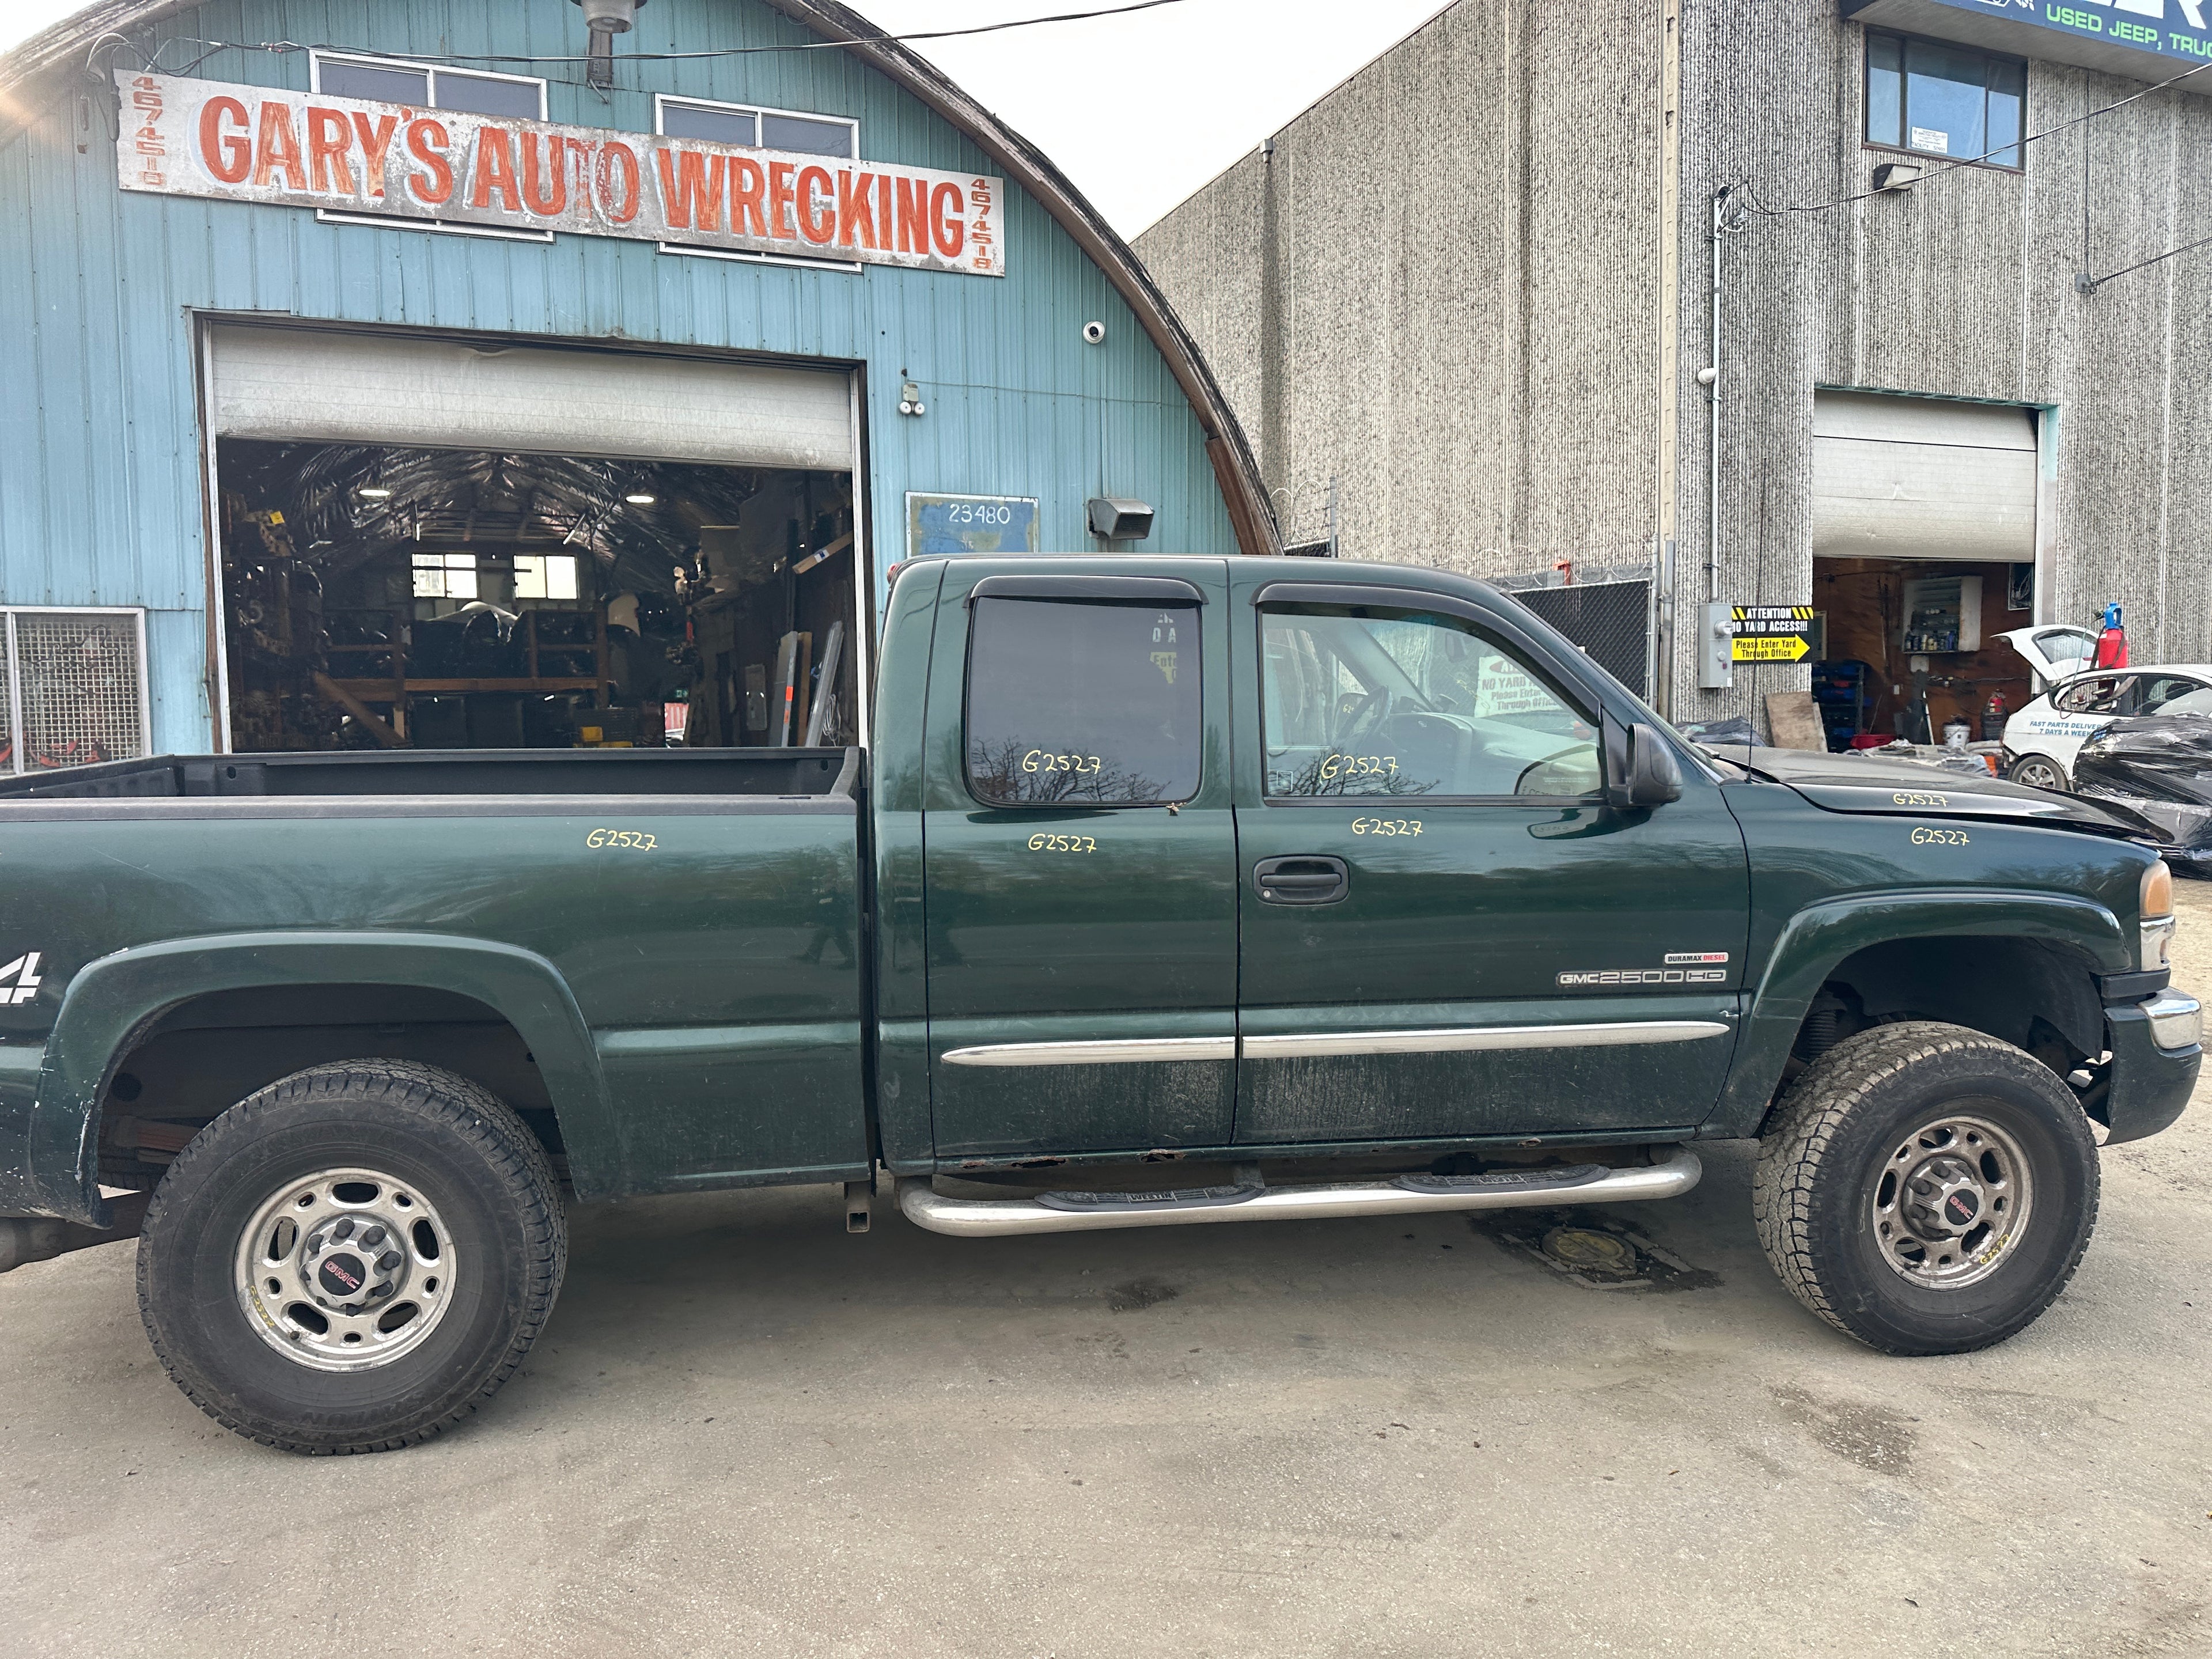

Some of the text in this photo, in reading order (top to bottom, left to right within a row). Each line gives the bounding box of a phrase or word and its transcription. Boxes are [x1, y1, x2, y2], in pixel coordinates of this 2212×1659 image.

[2046, 3, 2103, 33] USED
[2109, 21, 2162, 51] JEEP,
[198, 92, 965, 259] GARY'S AUTO WRECKING
[948, 503, 1011, 525] 23480
[1746, 607, 1791, 619] ATTENTION
[1744, 621, 1766, 632] YARD
[1768, 620, 1808, 632] ACCESS!!!
[1736, 639, 1796, 649] Please Enter Yard
[1741, 649, 1791, 658] Through Office
[1482, 678, 1495, 690] NO
[1491, 691, 1518, 700] Please
[1497, 698, 1531, 710] Through
[1021, 749, 1101, 774] G2527
[1321, 754, 1399, 779] G2527
[1893, 793, 1949, 806] G2527
[1351, 817, 1423, 837] G2527
[1911, 827, 1970, 846] G2527
[586, 828, 658, 851] G2527
[1027, 833, 1097, 853] G2527
[1949, 1195, 1974, 1219] GMC
[1980, 1233, 2010, 1264] G2527
[325, 1260, 360, 1289] GMC
